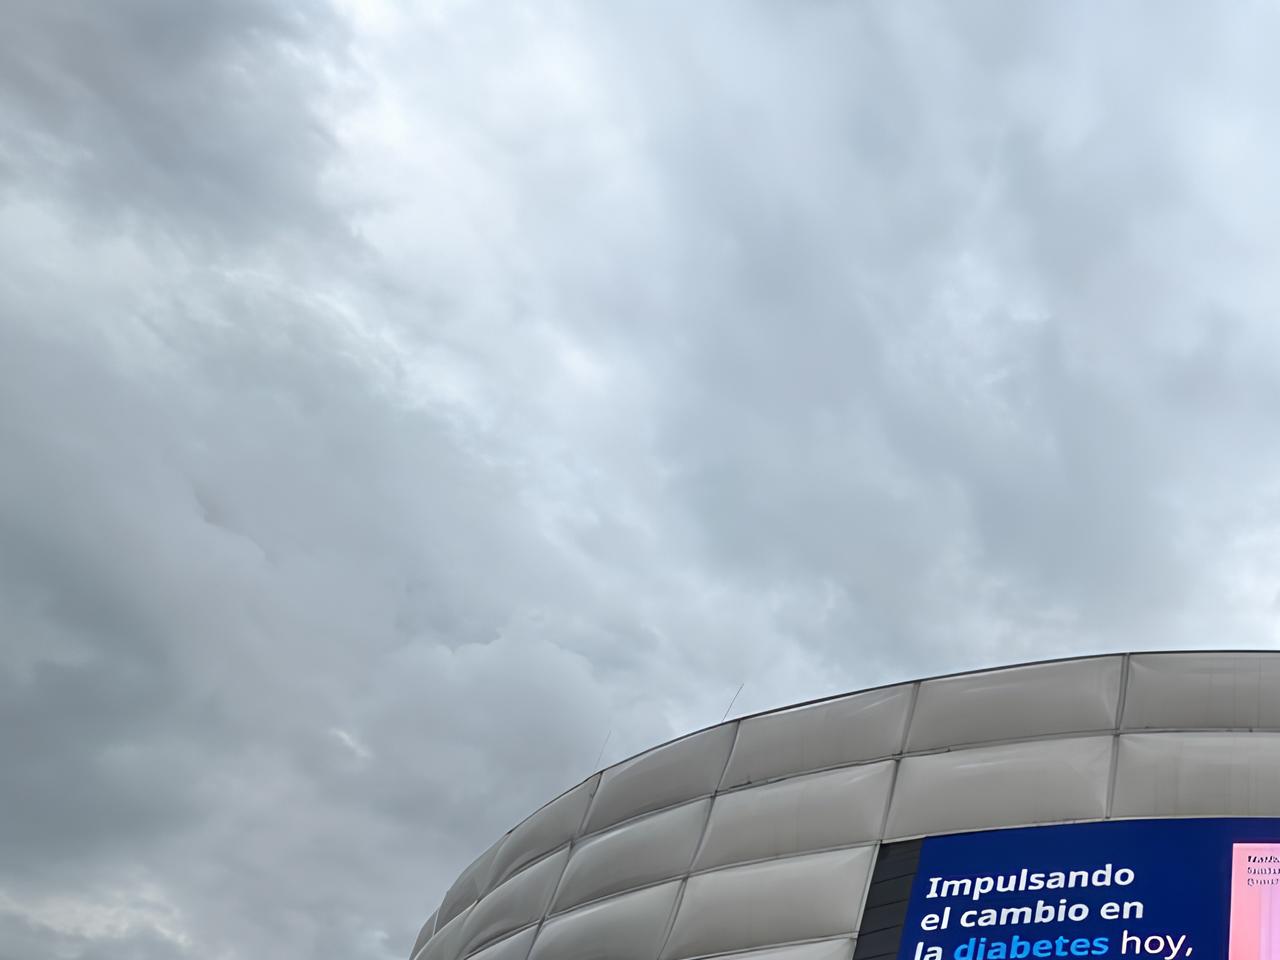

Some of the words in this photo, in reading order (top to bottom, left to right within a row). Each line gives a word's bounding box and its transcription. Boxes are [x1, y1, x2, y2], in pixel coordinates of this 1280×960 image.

[925, 863, 1136, 900] Impulsando
[921, 907, 951, 930] el
[959, 899, 1089, 927] cambio
[1100, 901, 1143, 919] en
[954, 936, 1108, 960] diabetes
[1122, 930, 1192, 960] hoy,
